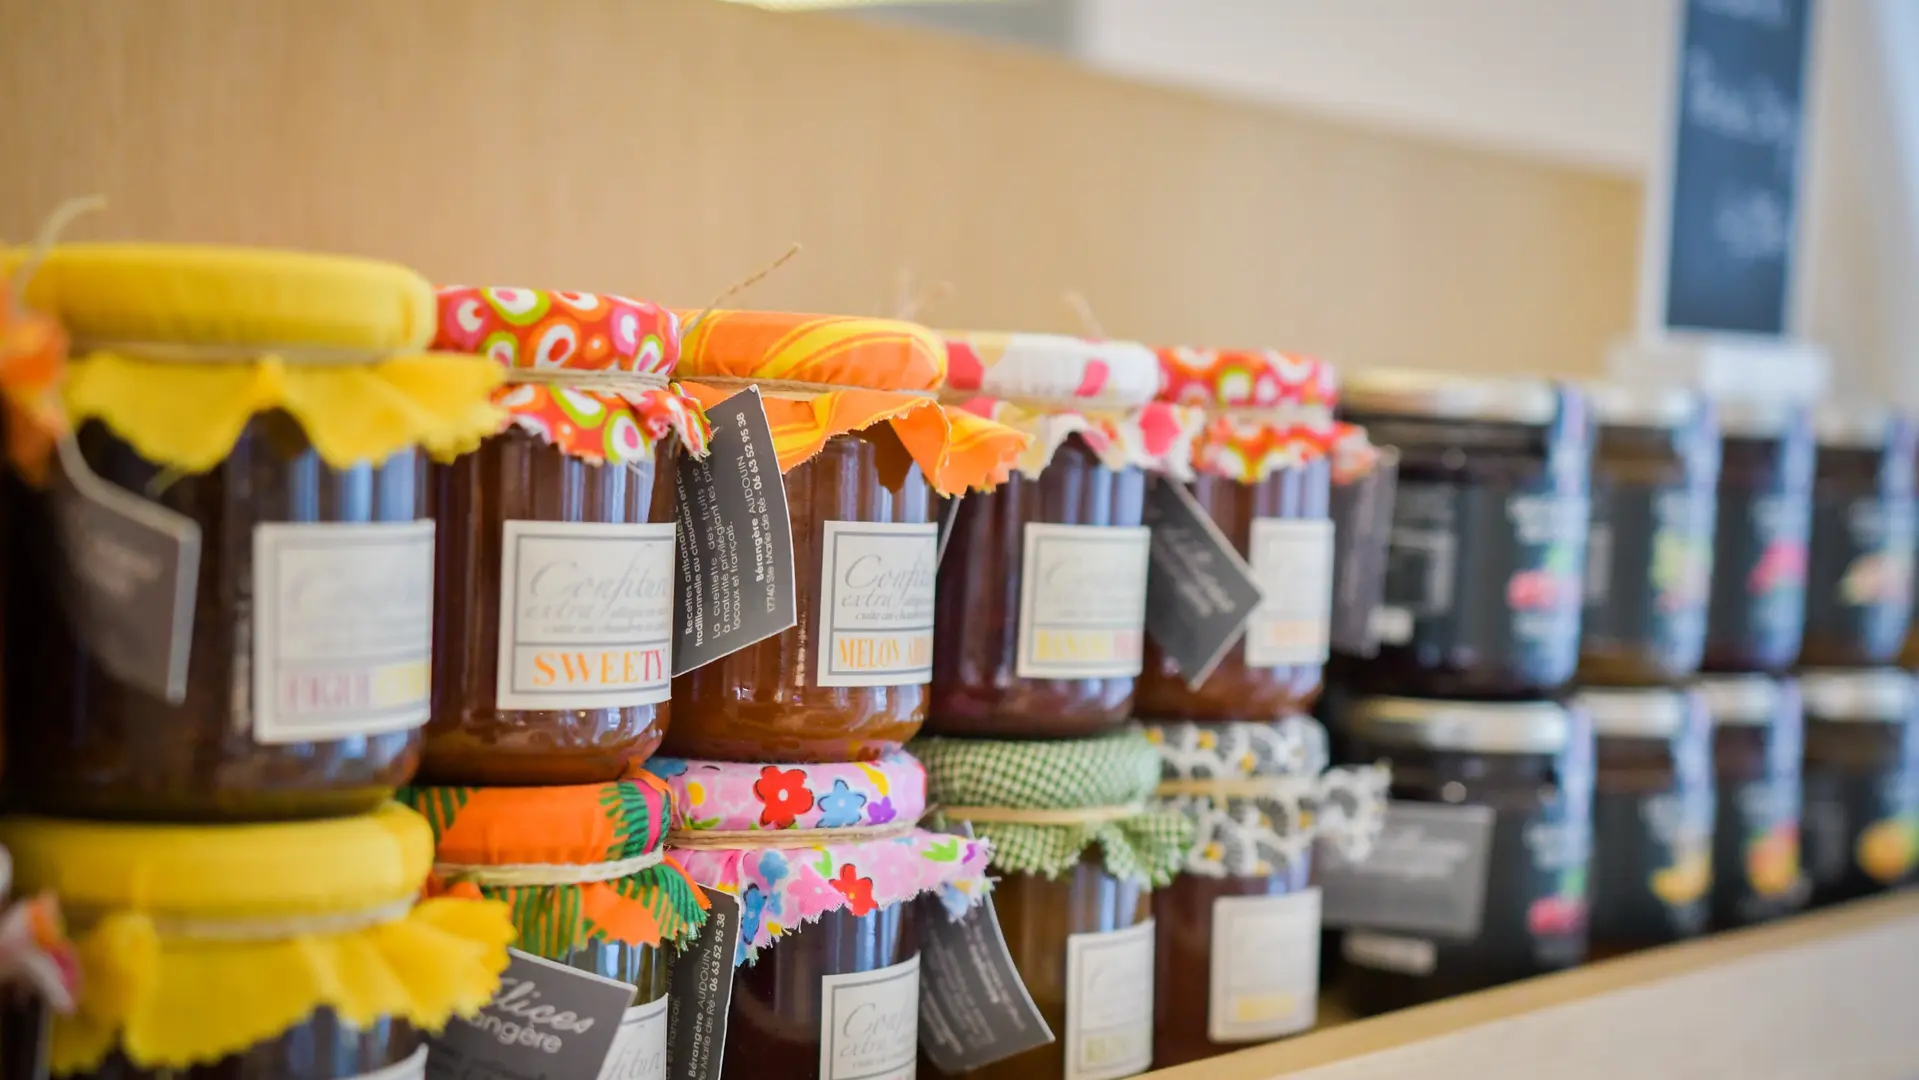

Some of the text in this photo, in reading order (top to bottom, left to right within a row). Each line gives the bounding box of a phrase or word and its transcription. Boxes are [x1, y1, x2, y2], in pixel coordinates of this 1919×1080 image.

[736, 412, 747, 427] 38
[740, 428, 750, 443] 95
[744, 443, 755, 458] 52
[748, 459, 759, 473] 63
[753, 475, 762, 490] 06
[707, 485, 717, 503] les
[697, 488, 710, 521] fruits
[757, 497, 767, 513] Ré
[737, 455, 764, 582] Bérangère AUDOUIN
[761, 513, 770, 531] de
[682, 502, 698, 556] chaudron
[706, 526, 715, 550] des
[710, 504, 729, 571] privilégiant
[764, 532, 774, 564] Marie
[693, 557, 701, 572] au
[710, 557, 720, 616] cueillette
[731, 575, 740, 587] et
[721, 573, 730, 622] maturité
[766, 584, 776, 613] 17740
[841, 588, 892, 608] extra
[685, 585, 693, 635] Recettes
[694, 573, 703, 647] traditionnelle
[732, 588, 741, 631] locaux
[713, 623, 721, 639] La
[838, 636, 900, 670] MELON
[532, 649, 666, 686] SWEETY
[716, 913, 726, 928] 38
[715, 928, 724, 942] 95
[713, 944, 723, 959] 52
[711, 961, 720, 975] 63
[709, 978, 719, 991] 06
[688, 1012, 704, 1078] Bérangère
[697, 948, 712, 1010] AUDOUIN
[706, 999, 716, 1015] Ré
[705, 1017, 714, 1034] de
[700, 1035, 711, 1069] Marie
